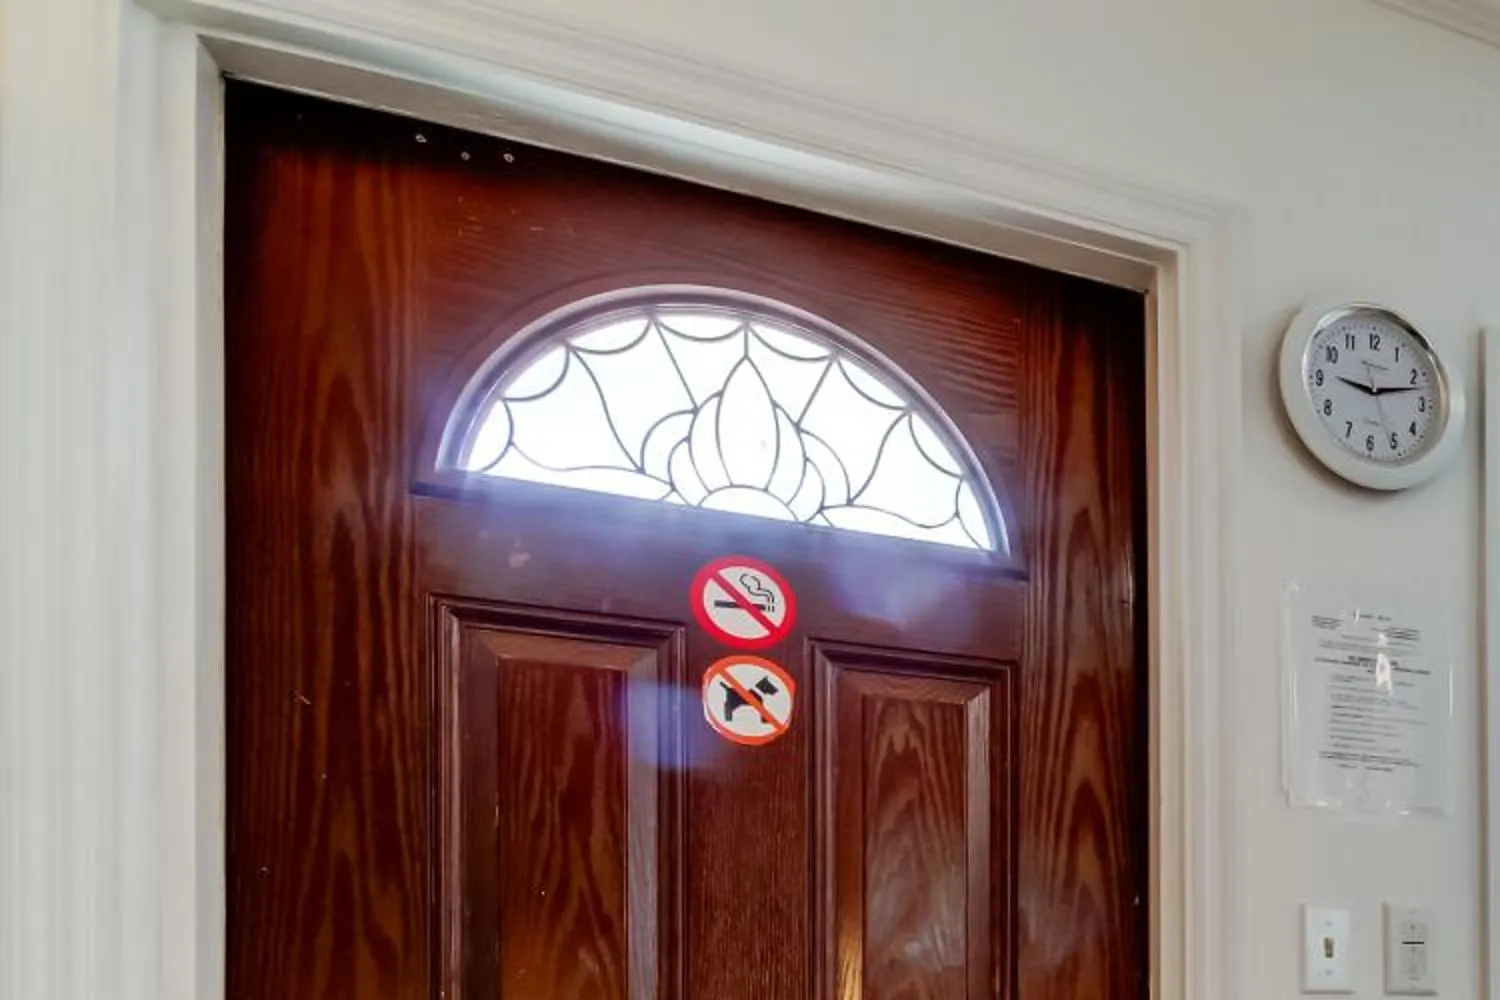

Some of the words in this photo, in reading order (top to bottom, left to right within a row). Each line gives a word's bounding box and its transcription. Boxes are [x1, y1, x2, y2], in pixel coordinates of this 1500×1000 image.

[1345, 333, 1355, 351] 11
[1369, 333, 1381, 351] 12
[1326, 345, 1339, 364] 10
[1394, 347, 1400, 363] 1
[1315, 369, 1325, 387] 9
[1409, 368, 1418, 385] 2
[1323, 399, 1333, 416] 8
[1418, 396, 1426, 413] 3
[1344, 421, 1353, 439] 7
[1409, 421, 1417, 436] 4
[1365, 435, 1375, 452] 6
[1389, 432, 1398, 450] 5
